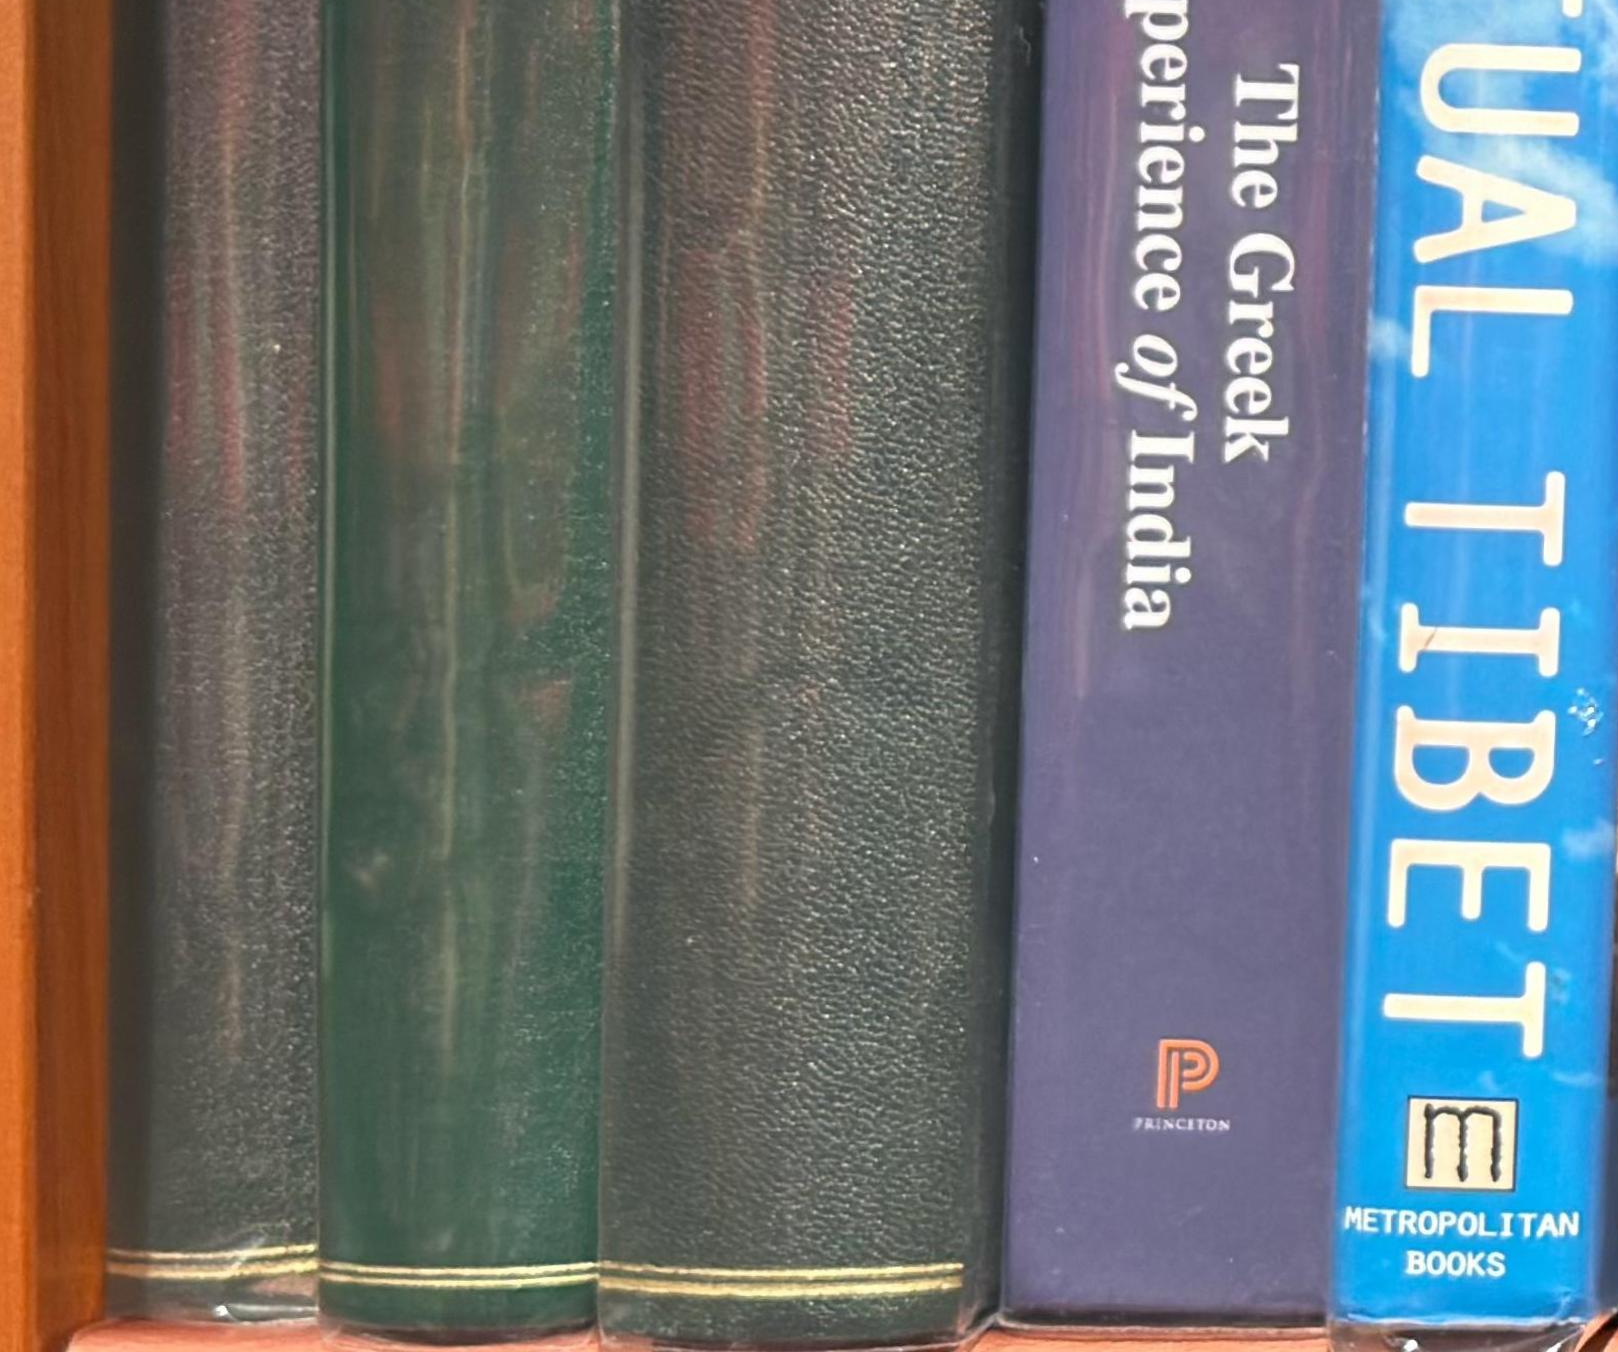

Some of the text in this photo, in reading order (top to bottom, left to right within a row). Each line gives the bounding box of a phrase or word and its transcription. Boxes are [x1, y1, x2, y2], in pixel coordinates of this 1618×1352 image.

[1223, 62, 1300, 465] The Greek
[1115, 334, 1196, 420] of
[1122, 428, 1195, 632] India
[1382, 470, 1566, 1059] TIBET
[1132, 1116, 1231, 1131] PRINCETON
[1343, 1206, 1581, 1239] METROPOLITAN
[1405, 1248, 1507, 1279] BOOKS
